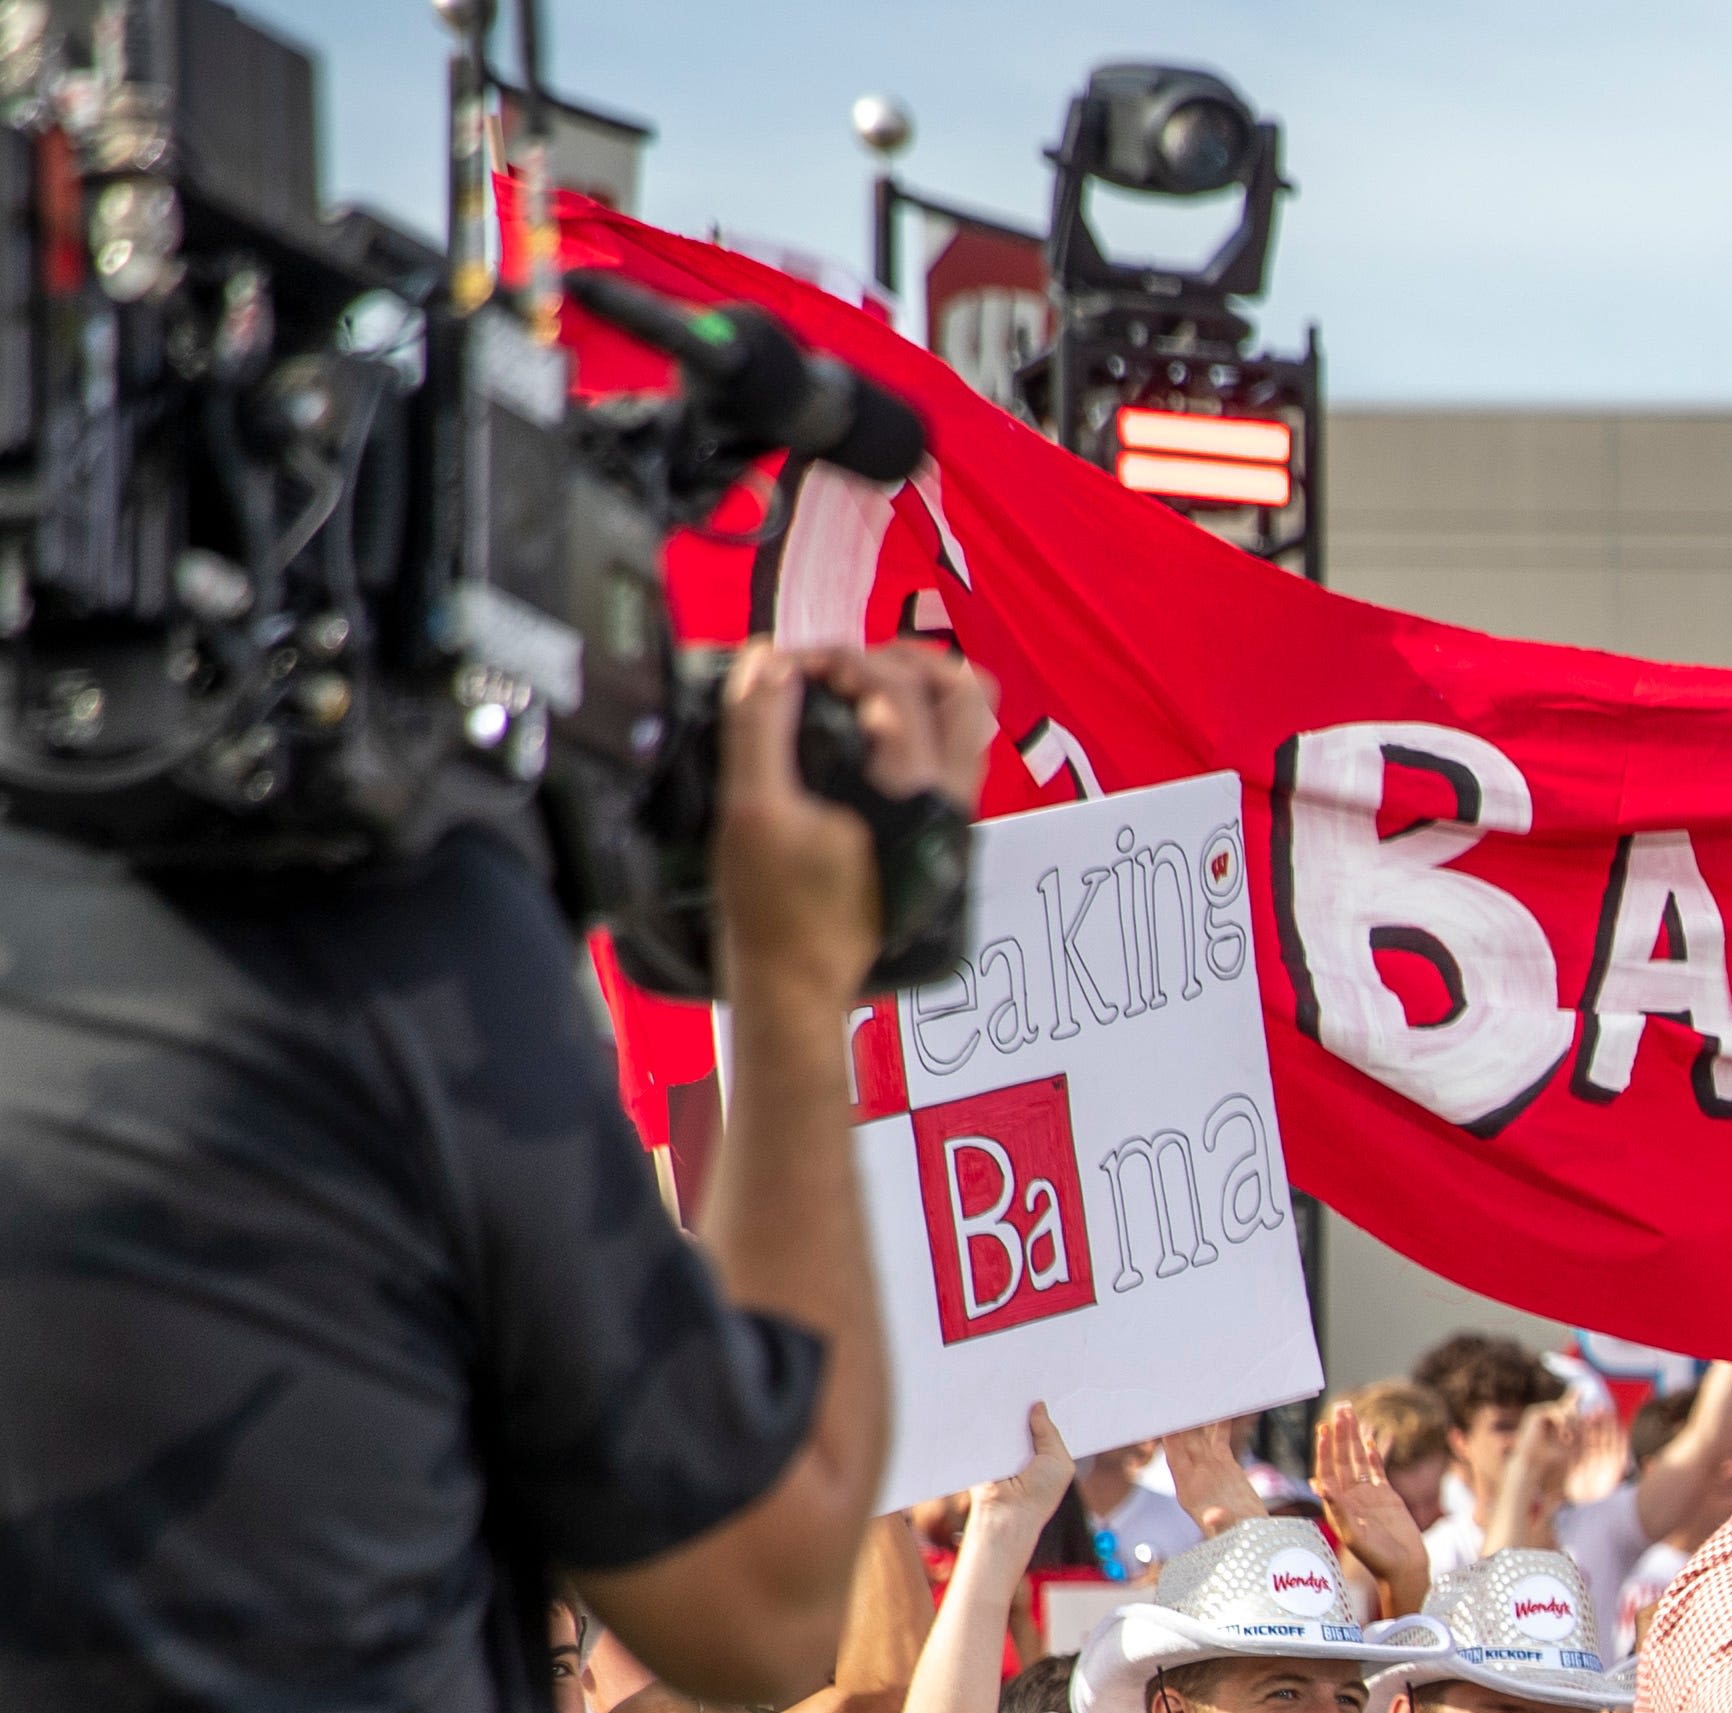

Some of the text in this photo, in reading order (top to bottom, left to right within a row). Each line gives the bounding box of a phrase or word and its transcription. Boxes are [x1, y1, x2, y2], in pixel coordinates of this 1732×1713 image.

[843, 818, 1248, 1106] reaking
[942, 1091, 1285, 1321] Bama
[1272, 1570, 1333, 1594] Wendy's
[1514, 1596, 1574, 1620] Wendy's
[1243, 1625, 1306, 1638] KICKOFF
[1485, 1649, 1544, 1663] KICKOFF
